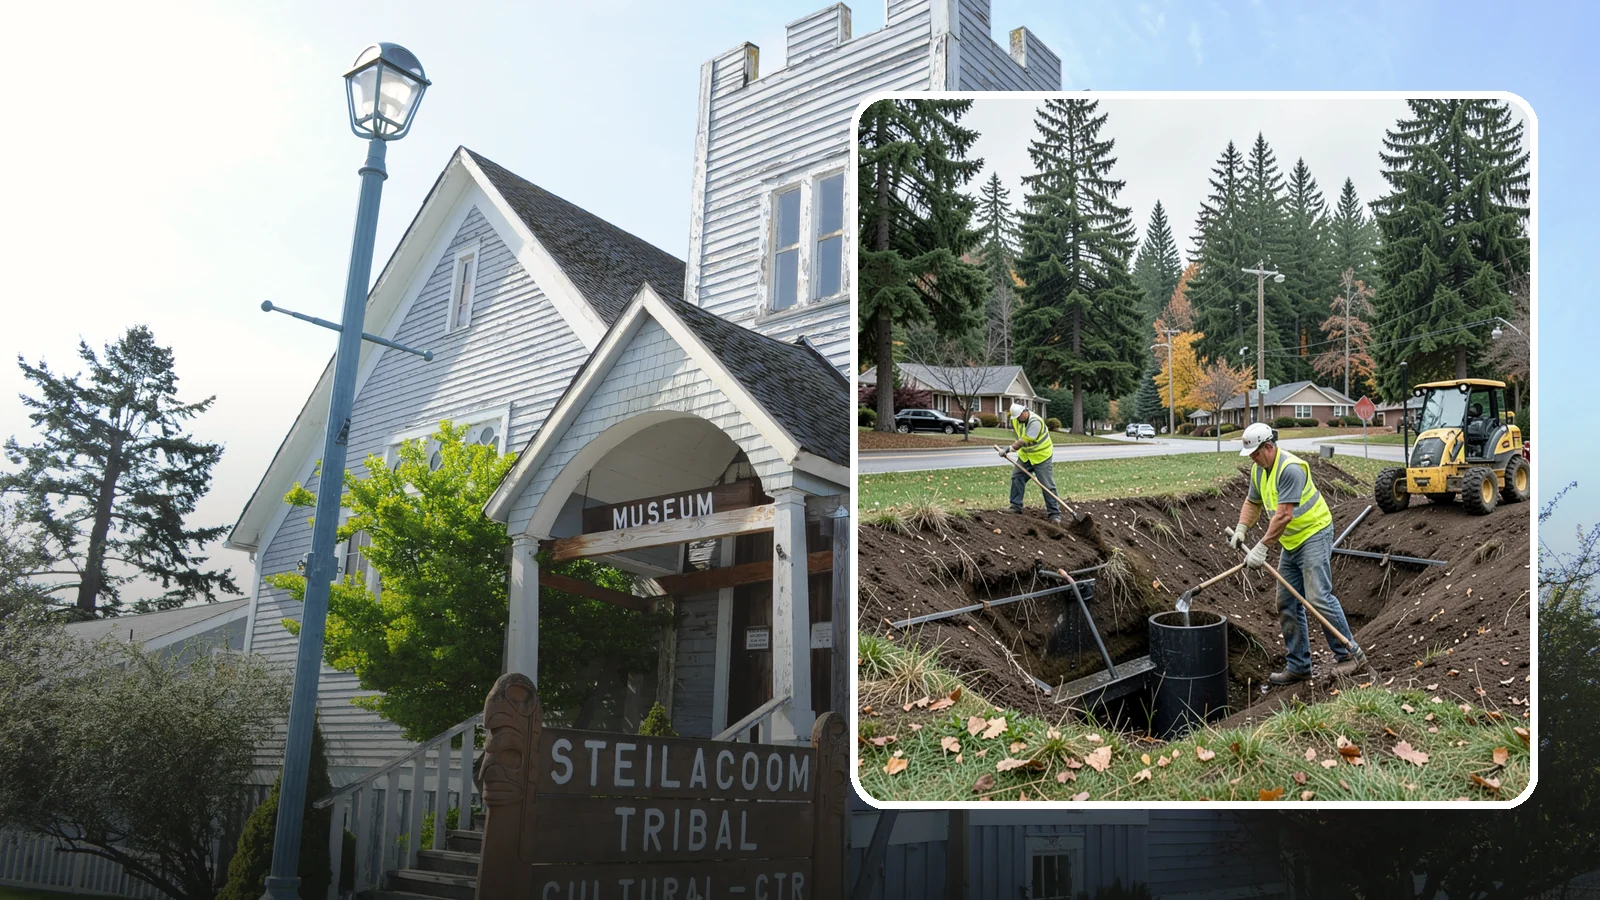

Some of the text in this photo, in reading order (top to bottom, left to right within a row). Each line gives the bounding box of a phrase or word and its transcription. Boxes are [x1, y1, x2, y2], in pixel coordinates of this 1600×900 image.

[613, 491, 713, 530] MUSEUM
[551, 738, 809, 792] STEILACOOM
[614, 806, 757, 852] TRIBAL
